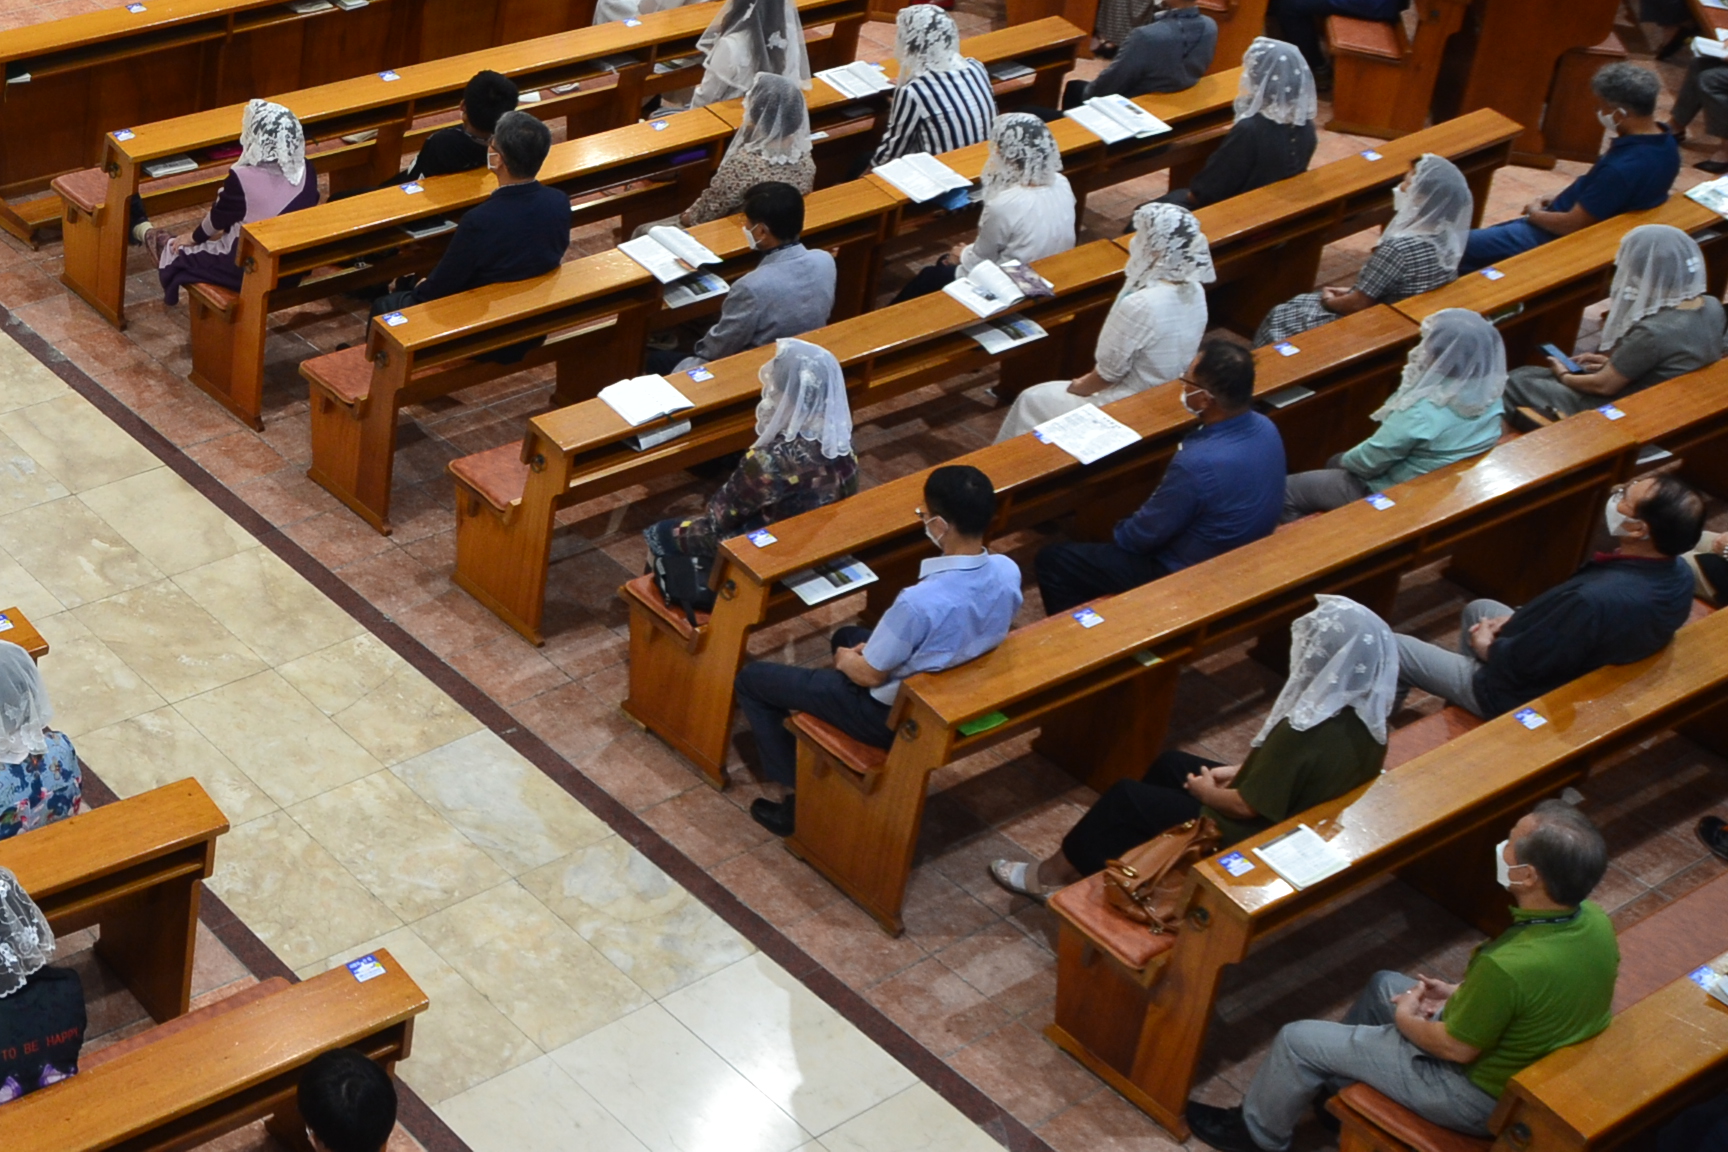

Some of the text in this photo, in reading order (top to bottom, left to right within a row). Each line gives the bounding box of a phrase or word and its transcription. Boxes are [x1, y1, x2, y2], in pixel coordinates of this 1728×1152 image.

[2, 1047, 17, 1061] TO
[24, 1039, 40, 1054] BE
[46, 1026, 80, 1047] HAPPY
